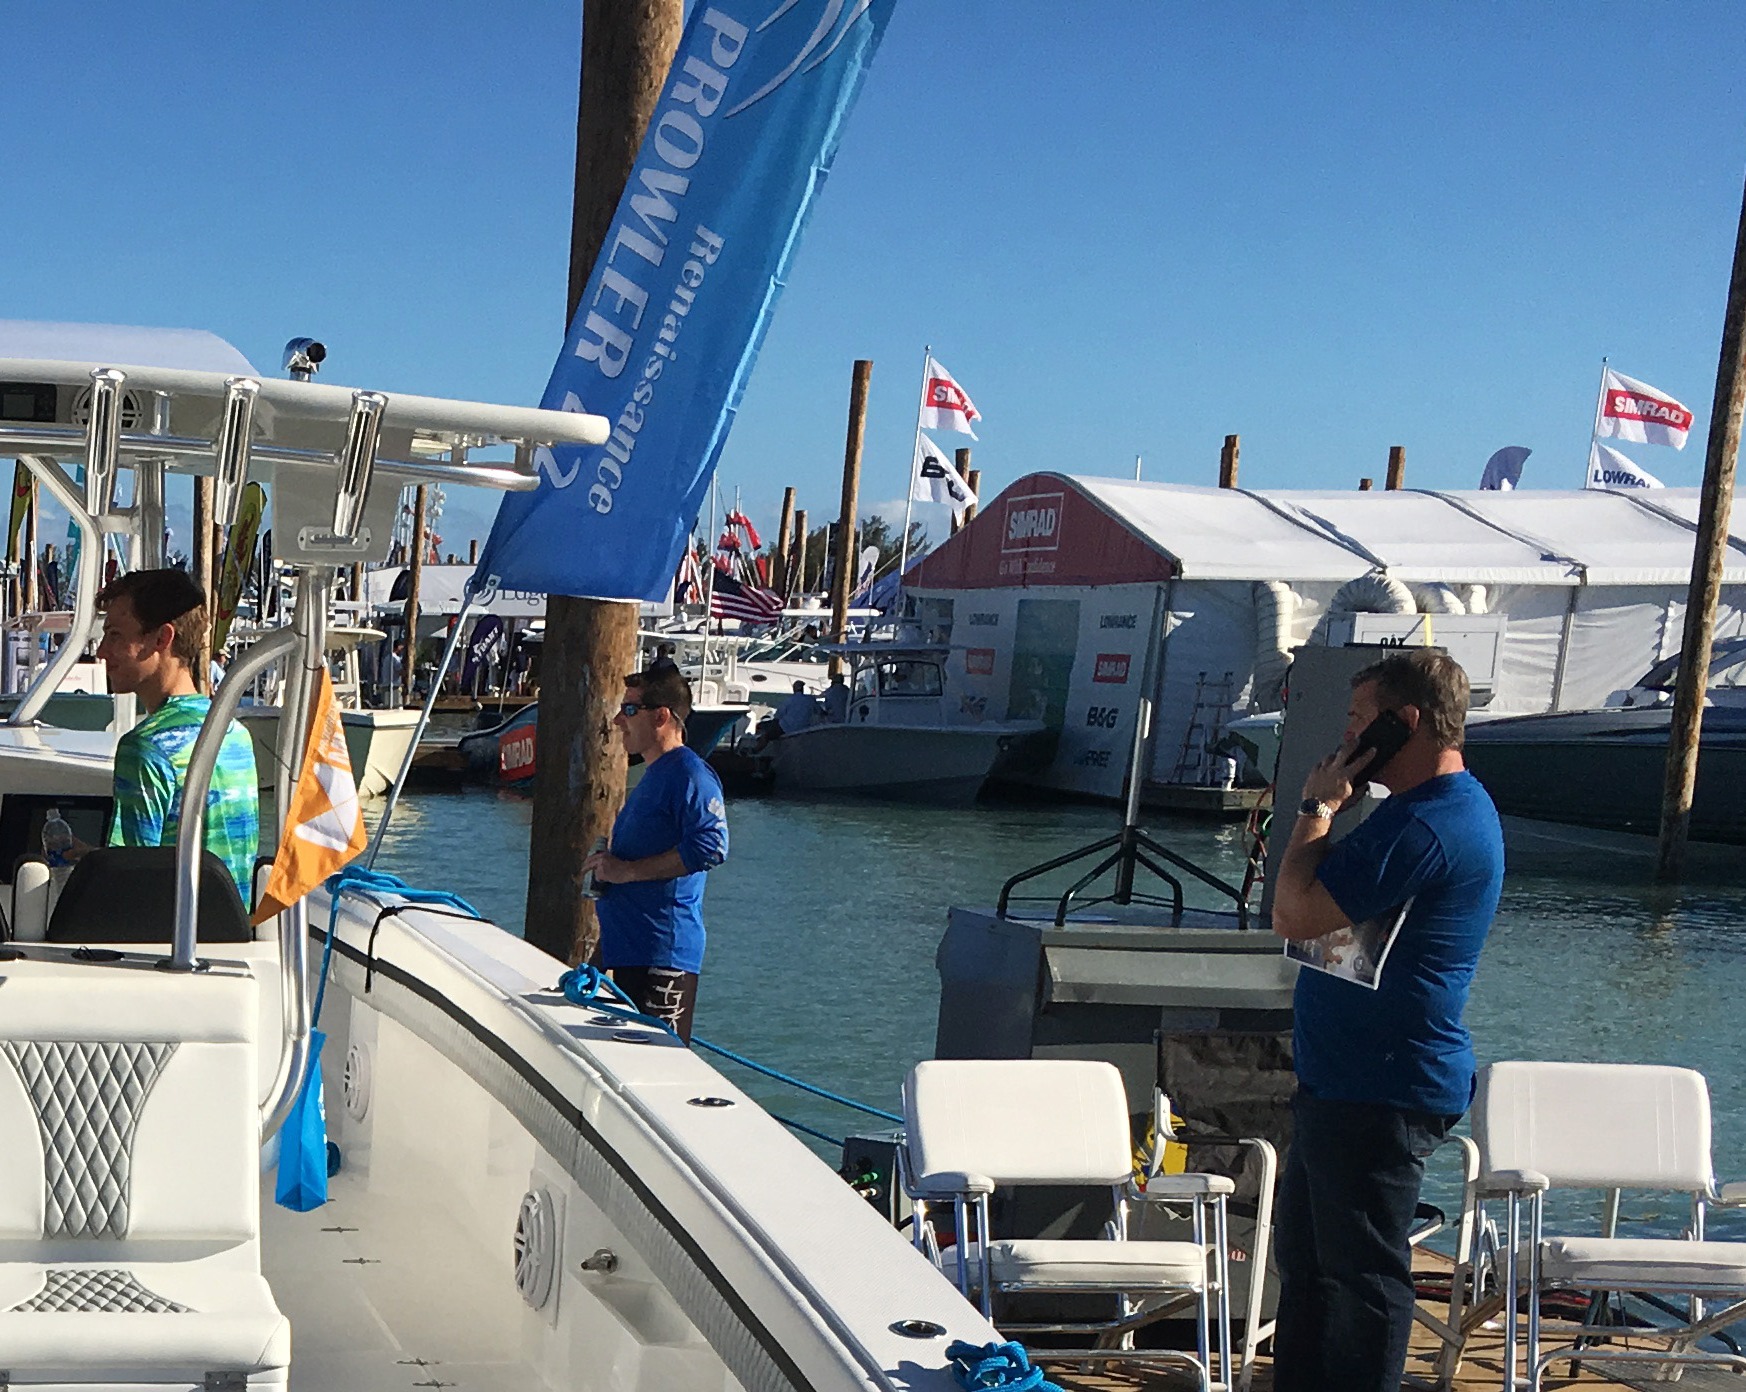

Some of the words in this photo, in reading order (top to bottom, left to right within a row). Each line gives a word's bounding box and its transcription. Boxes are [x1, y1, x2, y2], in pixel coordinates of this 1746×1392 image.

[575, 6, 750, 380] PROWLER
[587, 222, 727, 518] Renaissance
[1614, 395, 1685, 424] SIMRAD
[1008, 508, 1055, 540] SIMRAD
[1086, 706, 1119, 728] B&G
